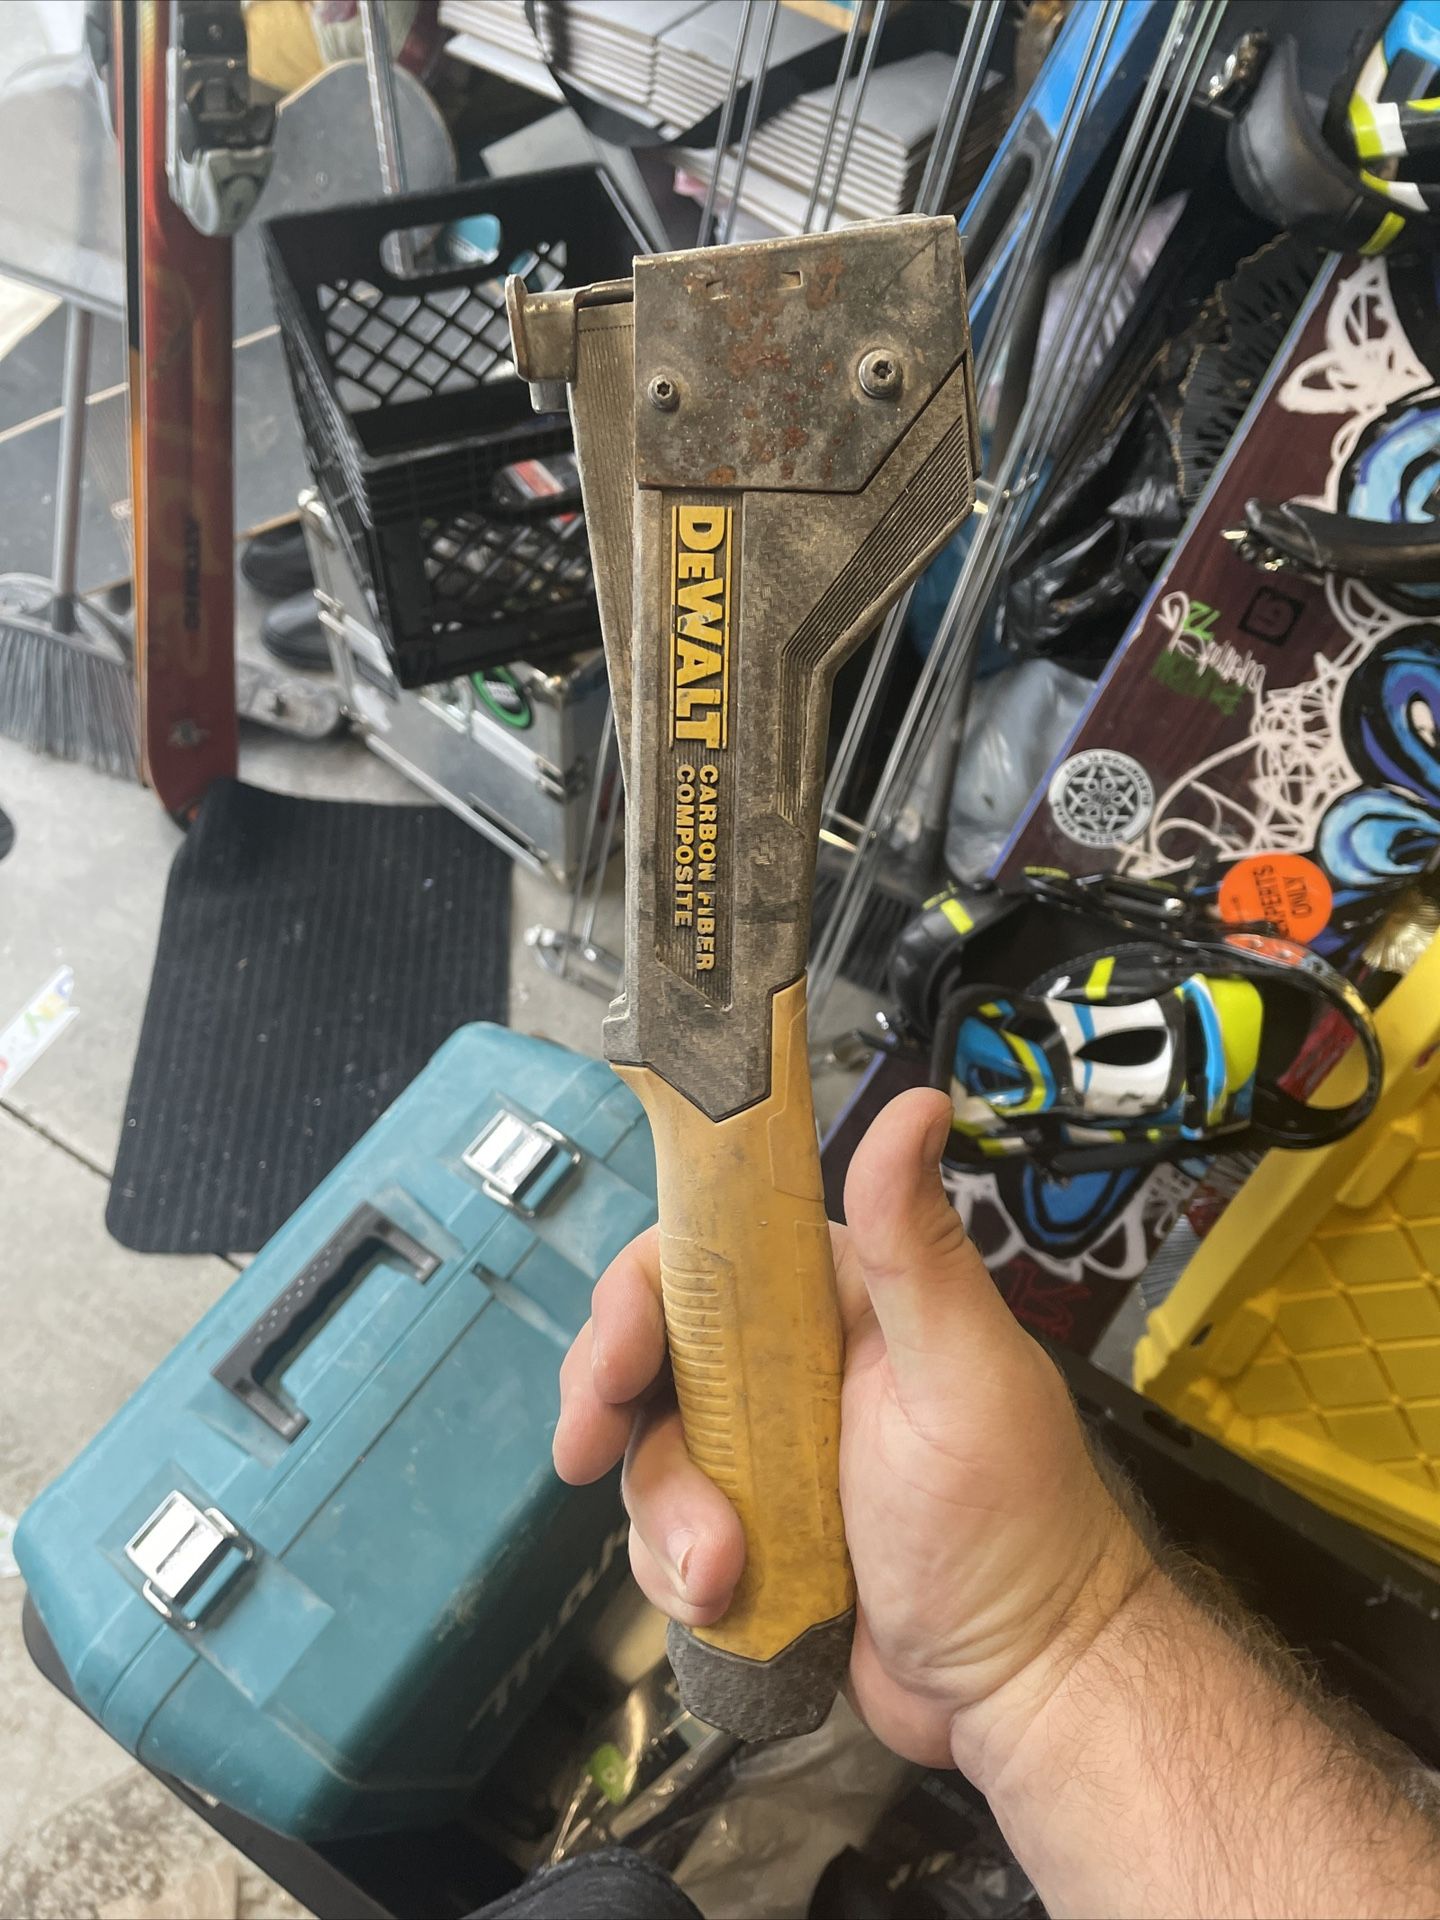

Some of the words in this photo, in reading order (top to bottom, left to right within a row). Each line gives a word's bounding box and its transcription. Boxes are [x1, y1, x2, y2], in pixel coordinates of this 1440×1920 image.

[676, 505, 725, 749] DEWALT
[674, 764, 695, 927] COMPOSITE
[698, 764, 718, 882] CARBON
[696, 891, 716, 971] FIBER
[1282, 876, 1312, 918] ONLY
